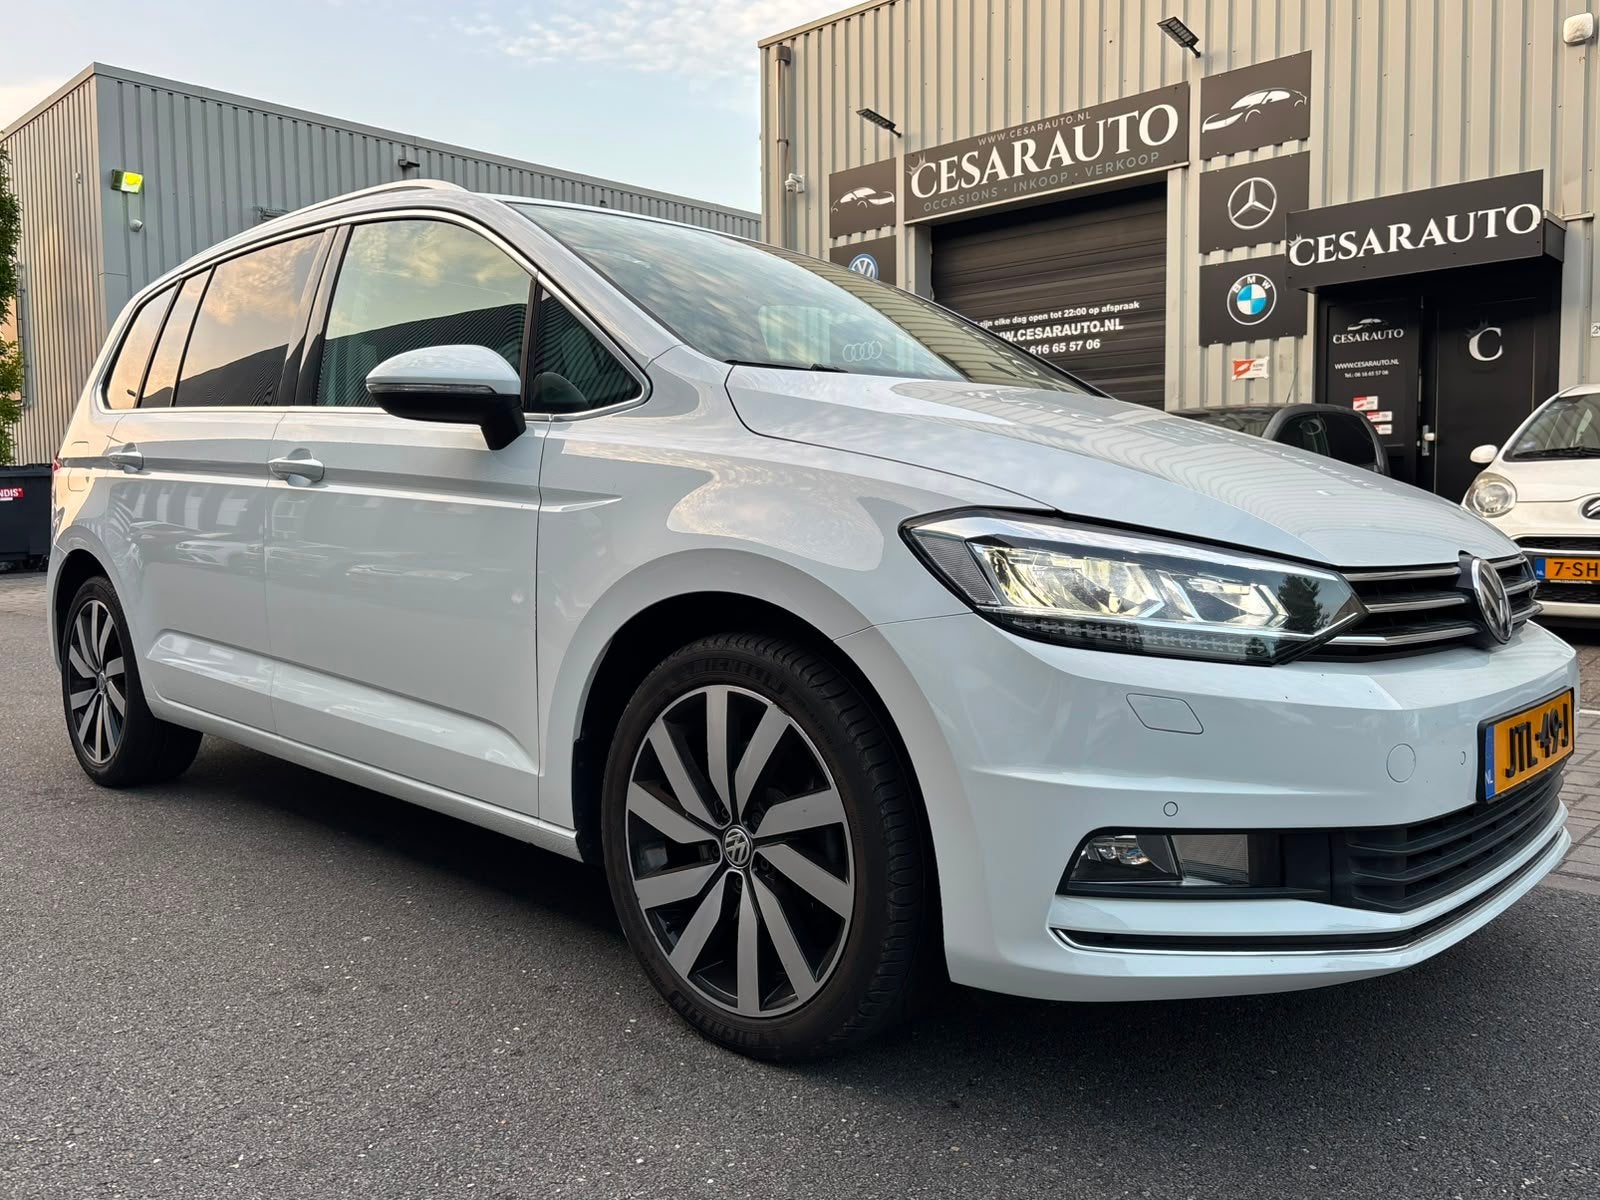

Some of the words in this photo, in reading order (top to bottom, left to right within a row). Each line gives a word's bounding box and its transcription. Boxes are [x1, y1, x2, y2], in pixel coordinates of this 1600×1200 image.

[978, 111, 1091, 146] WWW.CESARAUTO.NL
[911, 104, 1178, 198] CESARAUTO
[923, 187, 998, 212] OCCASIONS
[1013, 172, 1068, 193] INKOOP
[1085, 152, 1159, 177] VERKOOP
[1289, 203, 1541, 266] CESARAUTO
[1232, 275, 1271, 293] BMW
[994, 318, 1010, 326] elke
[1012, 316, 1027, 324] dag
[1028, 313, 1048, 322] open
[1050, 311, 1062, 319] tot
[1063, 307, 1087, 317] 22:00
[1088, 307, 1099, 315] op
[1101, 301, 1140, 313] afspraak
[1052, 343, 1066, 353] 65
[1069, 341, 1083, 351] 57
[1086, 339, 1101, 350] 06
[1332, 328, 1404, 344] CESARAUTO
[1334, 358, 1399, 370] WWW.CESARAUTO.NL
[1505, 703, 1569, 778] JTL-49-J
